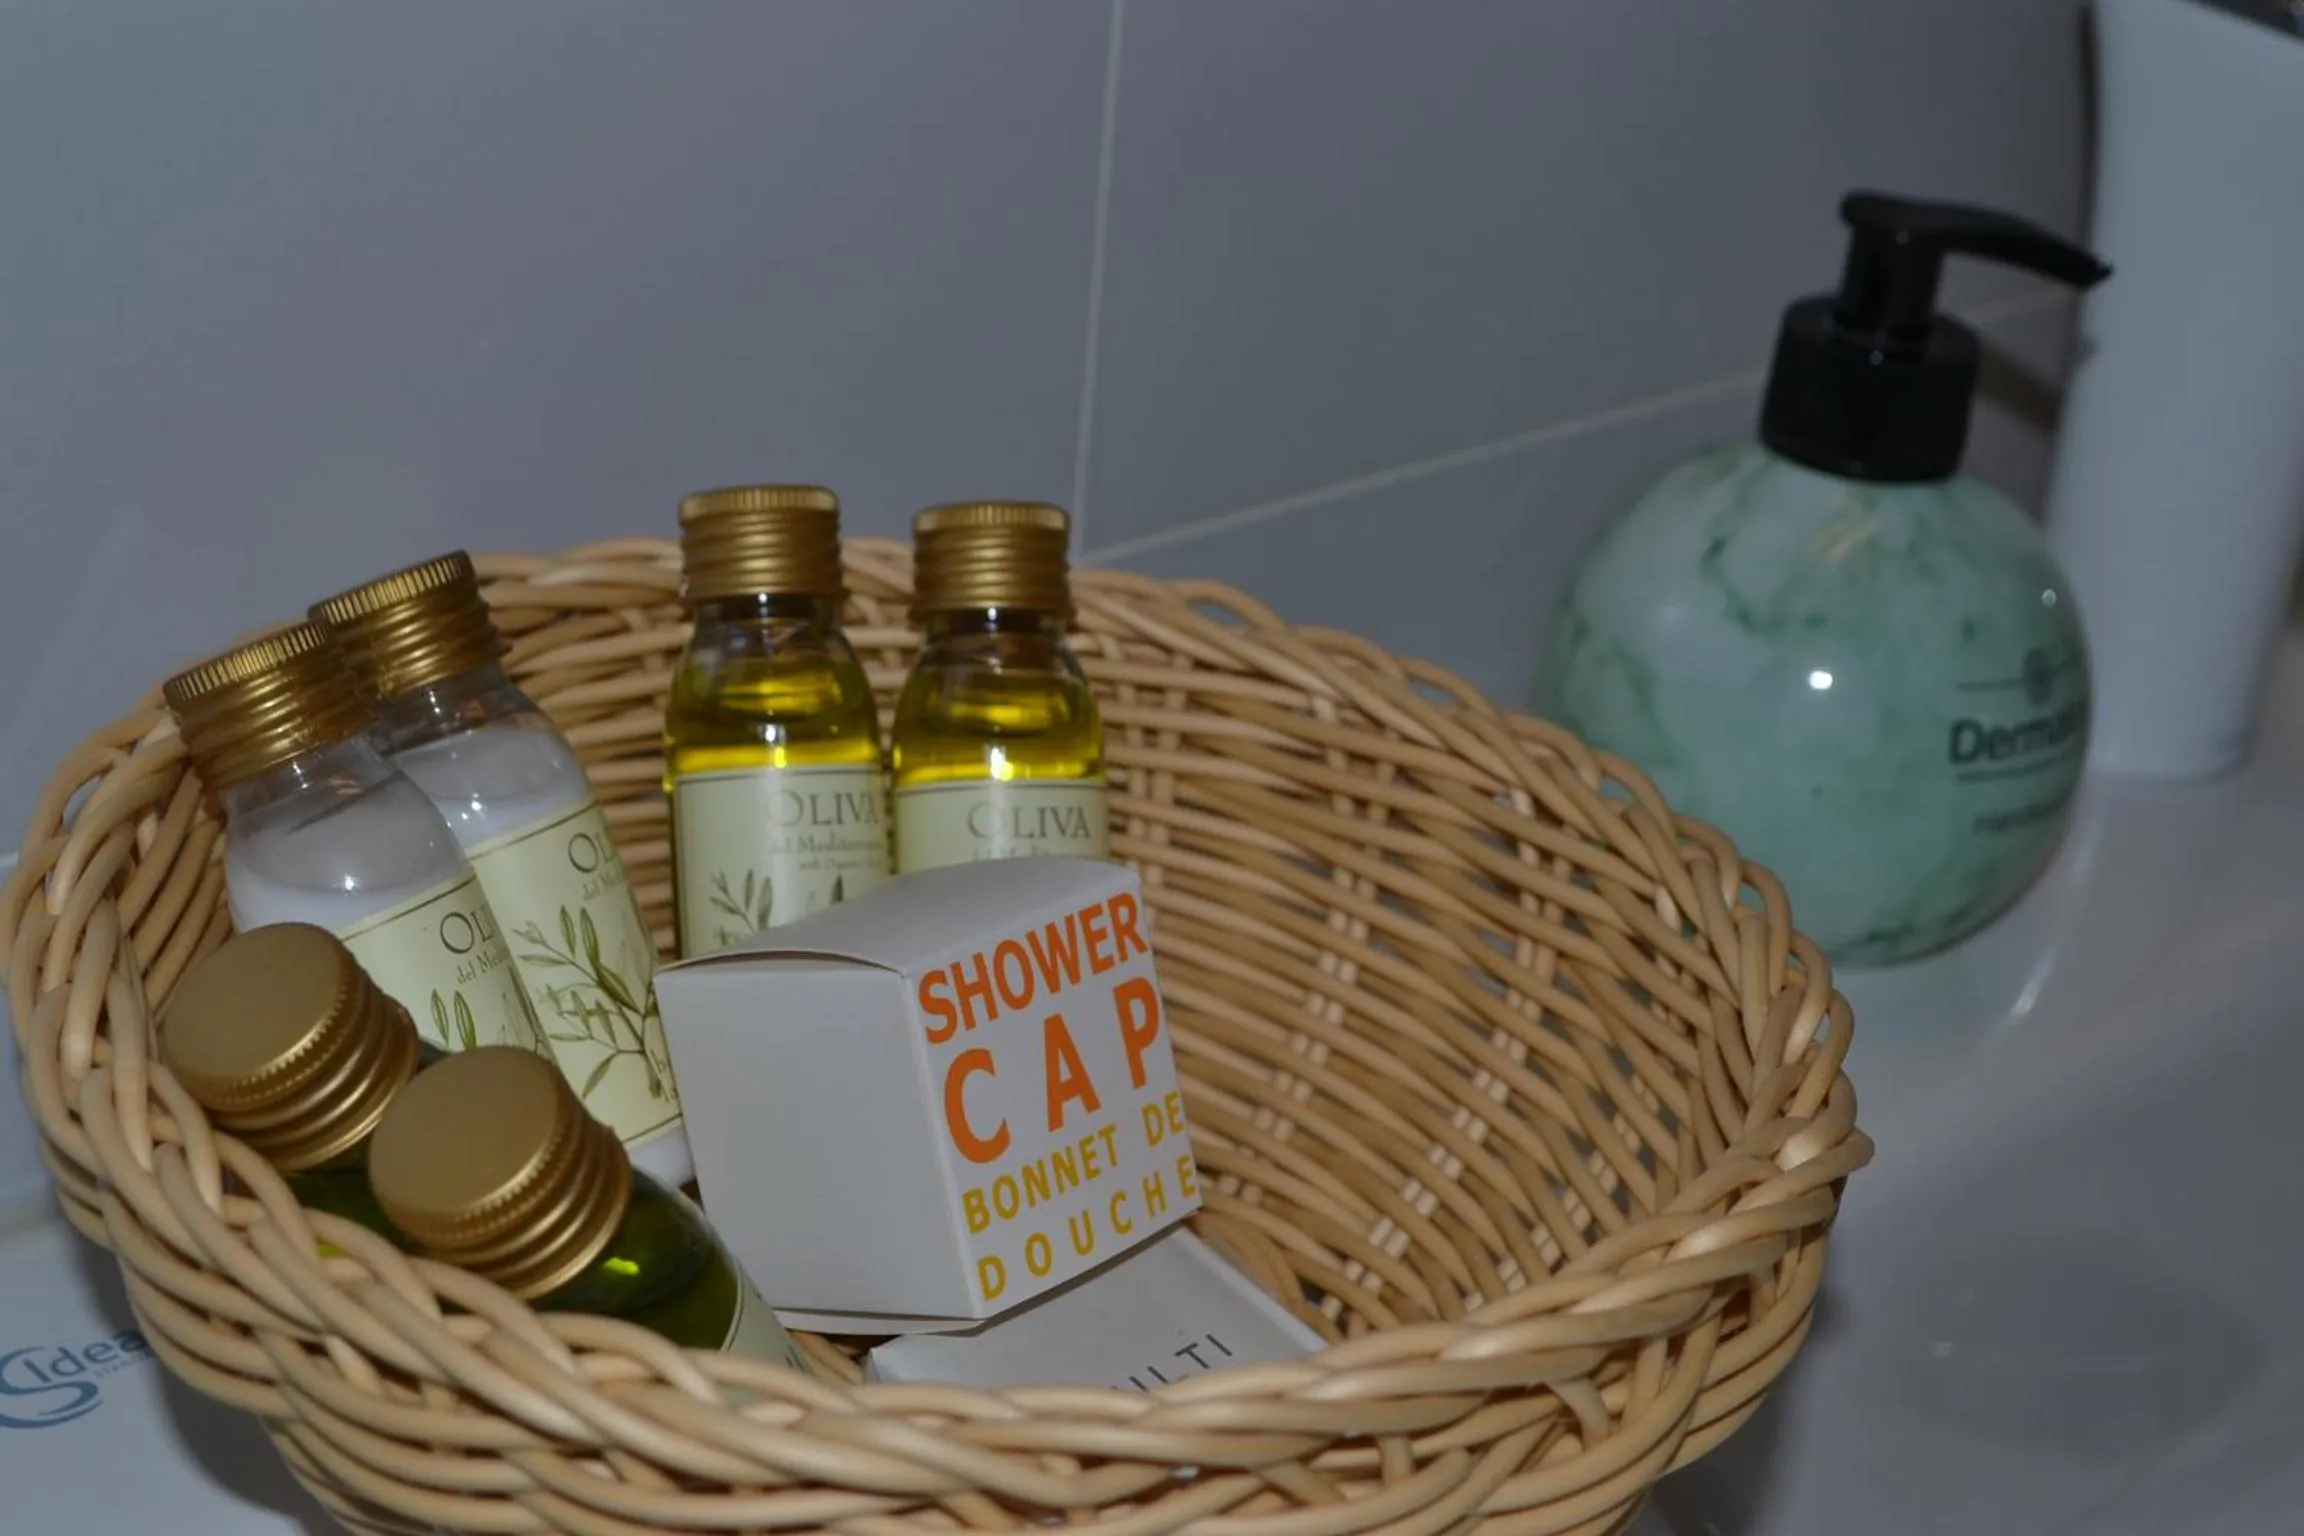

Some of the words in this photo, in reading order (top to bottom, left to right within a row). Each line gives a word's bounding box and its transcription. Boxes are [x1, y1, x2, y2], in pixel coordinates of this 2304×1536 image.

[567, 832, 617, 873] OL
[767, 789, 879, 826] OLIVA
[966, 801, 1092, 840] OLIVA
[918, 891, 1149, 1045] SHOWER
[943, 976, 1160, 1165] CAP
[962, 1123, 1118, 1236] BONNET
[1141, 1091, 1187, 1147] DE
[976, 1154, 1196, 1301] DOUCHE
[22, 1329, 156, 1384] Idea
